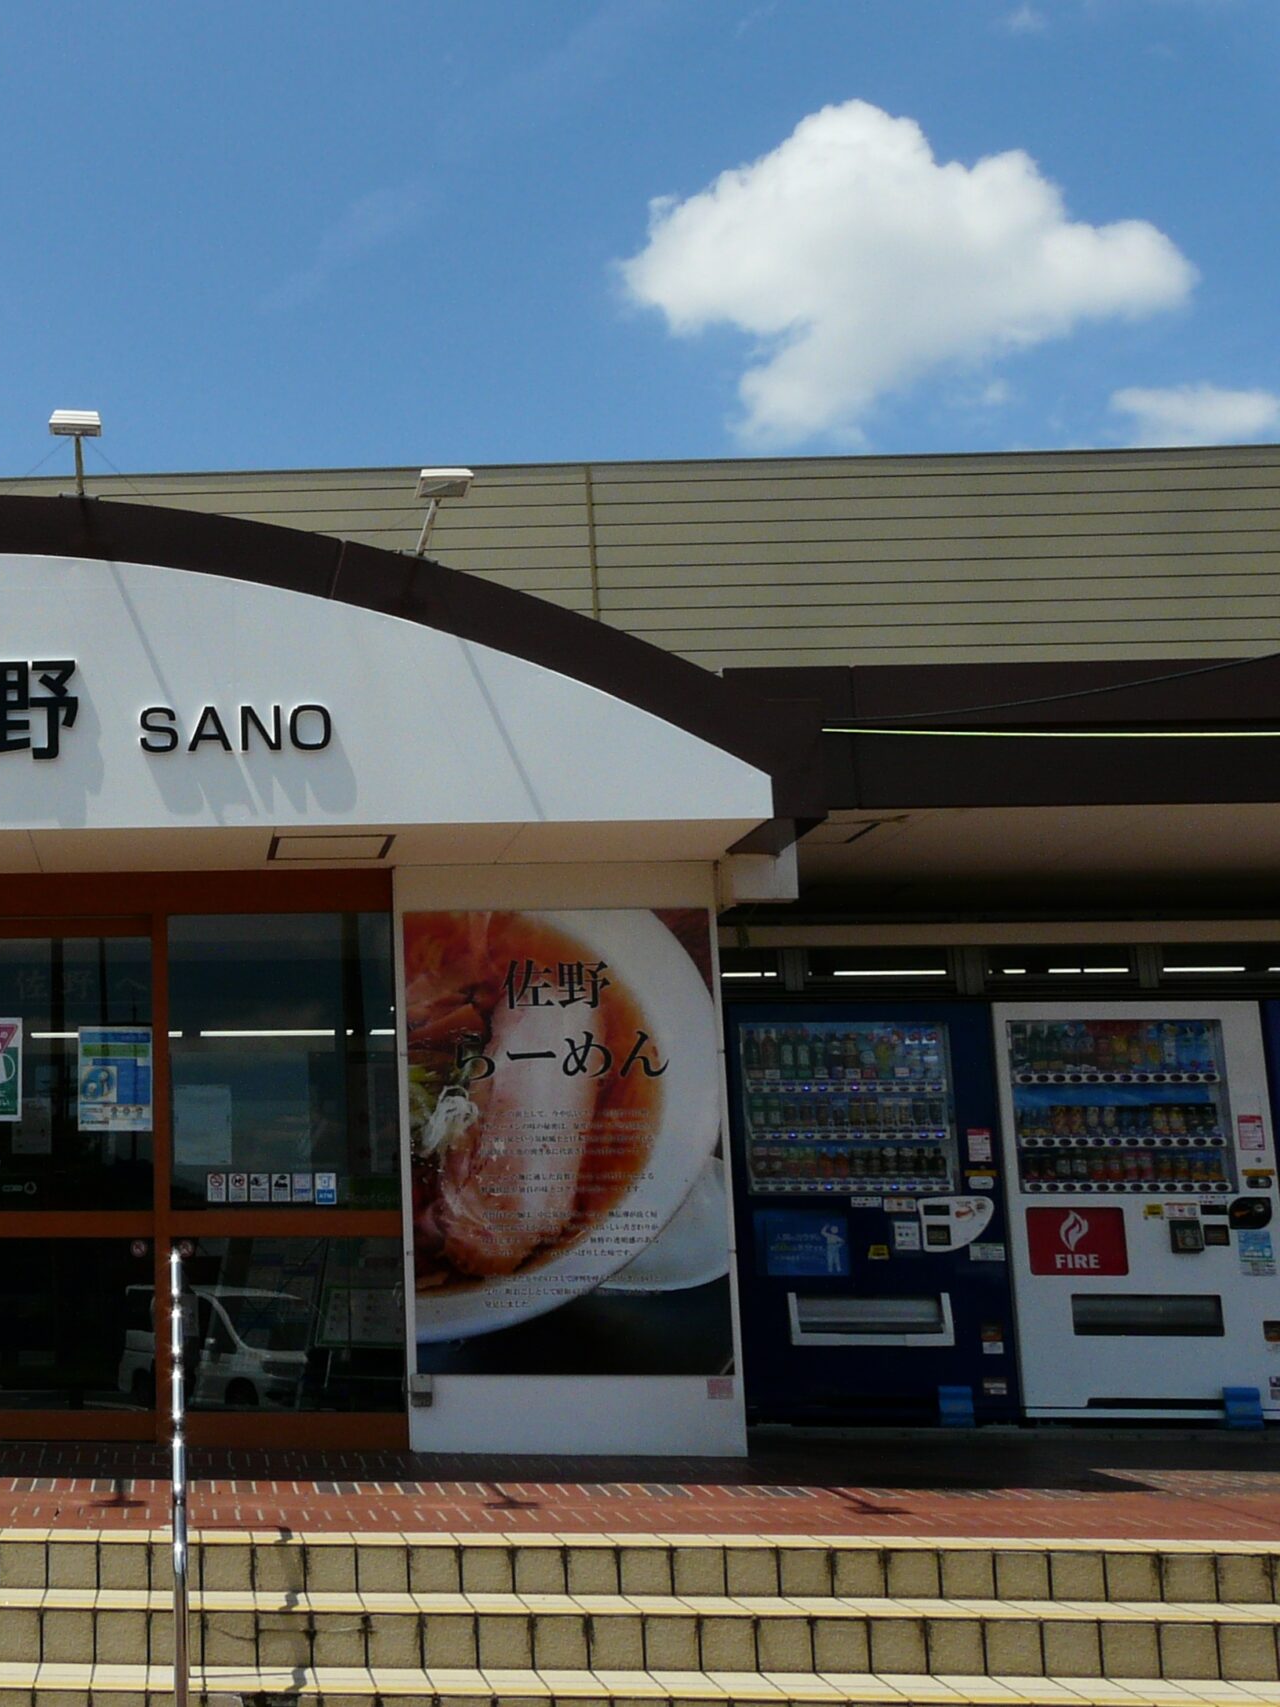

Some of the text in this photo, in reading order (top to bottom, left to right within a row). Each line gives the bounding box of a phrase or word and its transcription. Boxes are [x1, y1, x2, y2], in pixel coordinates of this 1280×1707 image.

[139, 704, 332, 754] SANO
[502, 958, 611, 1010] 佐野
[455, 1030, 671, 1081] らーめん
[318, 1192, 333, 1200] ATM
[1055, 1253, 1101, 1270] FIRE
